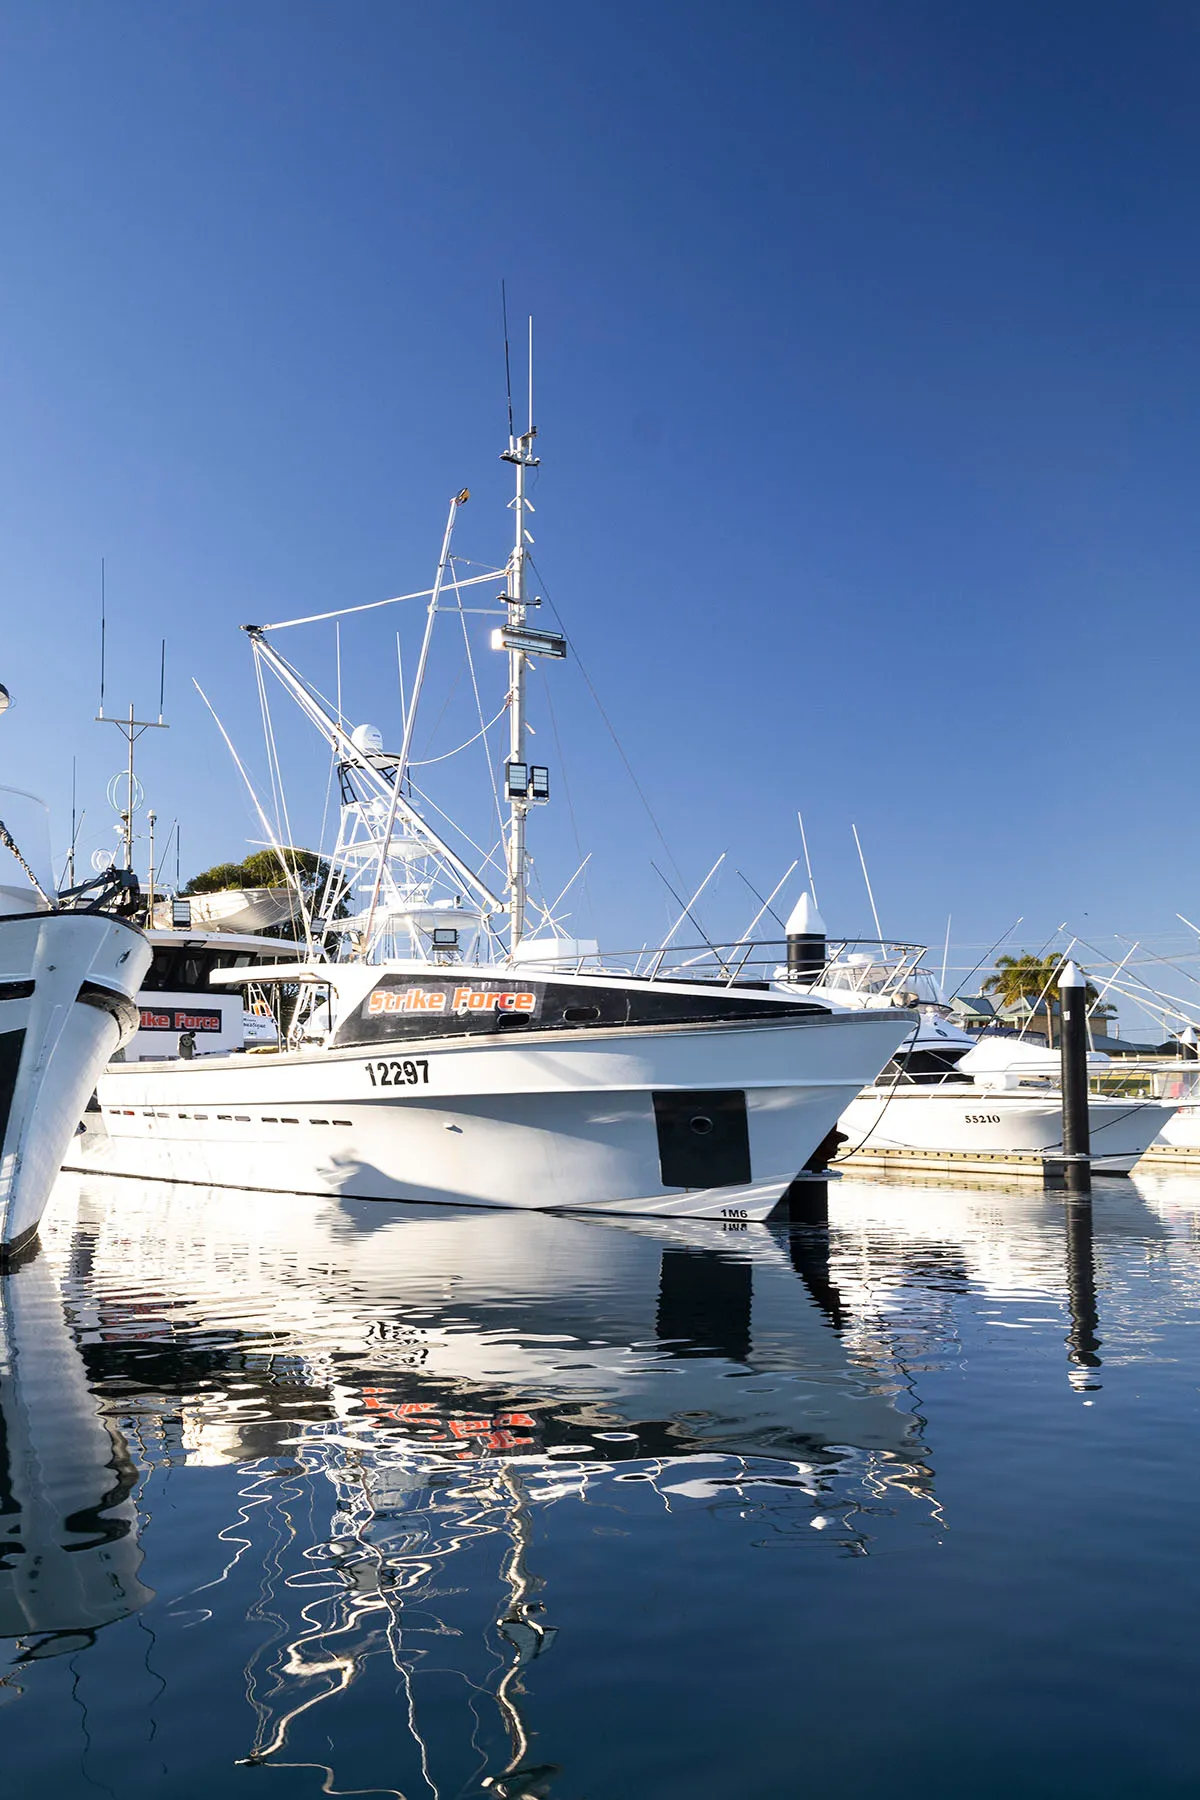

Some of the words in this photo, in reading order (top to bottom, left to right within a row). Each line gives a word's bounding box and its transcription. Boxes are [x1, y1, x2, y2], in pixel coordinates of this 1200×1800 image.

[368, 988, 446, 1015] Strike
[452, 986, 536, 1013] Force
[140, 1011, 170, 1029] ike
[174, 1012, 220, 1030] Force
[365, 1060, 429, 1087] 12297
[964, 1114, 1001, 1124] 55210
[720, 1208, 748, 1218] 1M6
